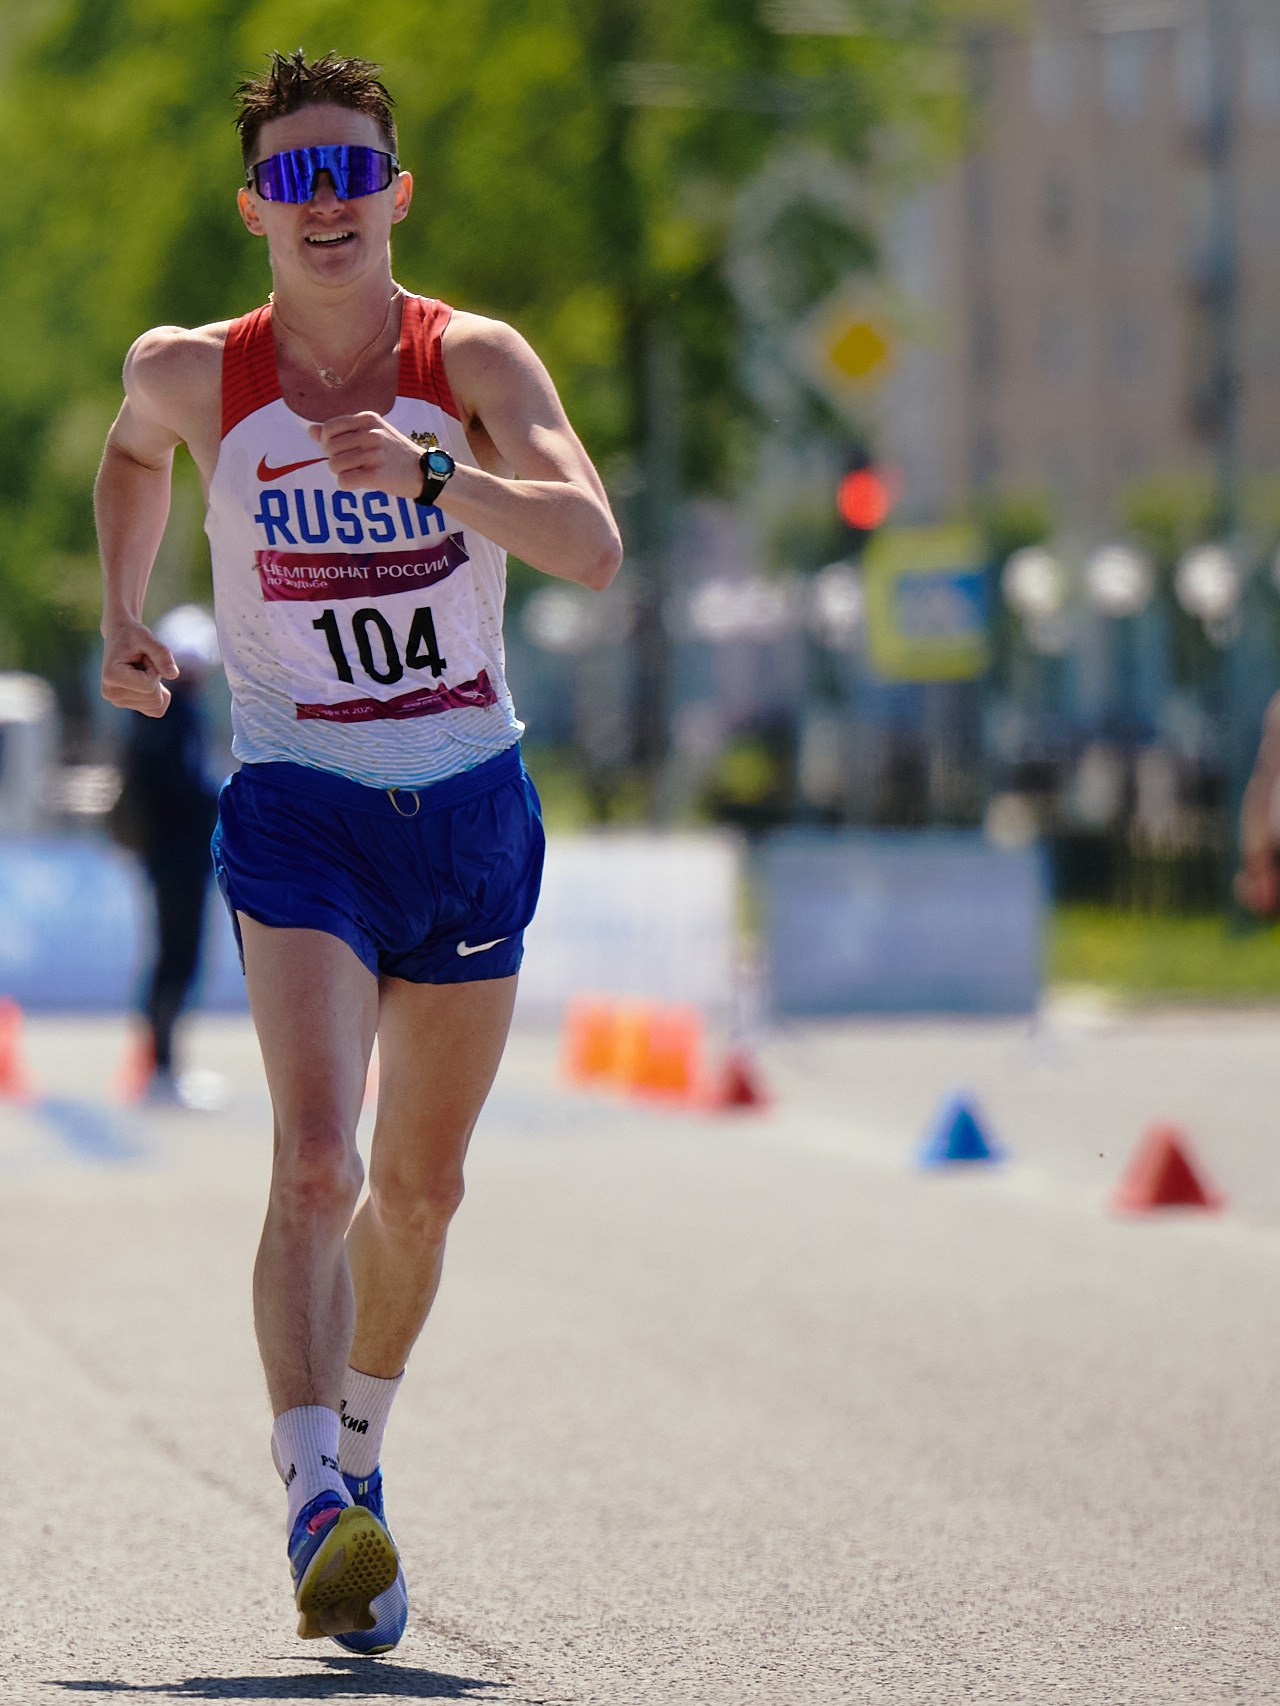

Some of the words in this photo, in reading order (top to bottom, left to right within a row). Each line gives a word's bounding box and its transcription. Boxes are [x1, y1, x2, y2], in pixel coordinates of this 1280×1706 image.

[263, 563, 370, 580] ЧЕМПИОНАТ
[376, 556, 449, 579] РОССИИ
[312, 607, 447, 685] 104
[340, 1413, 369, 1435] КИЙ
